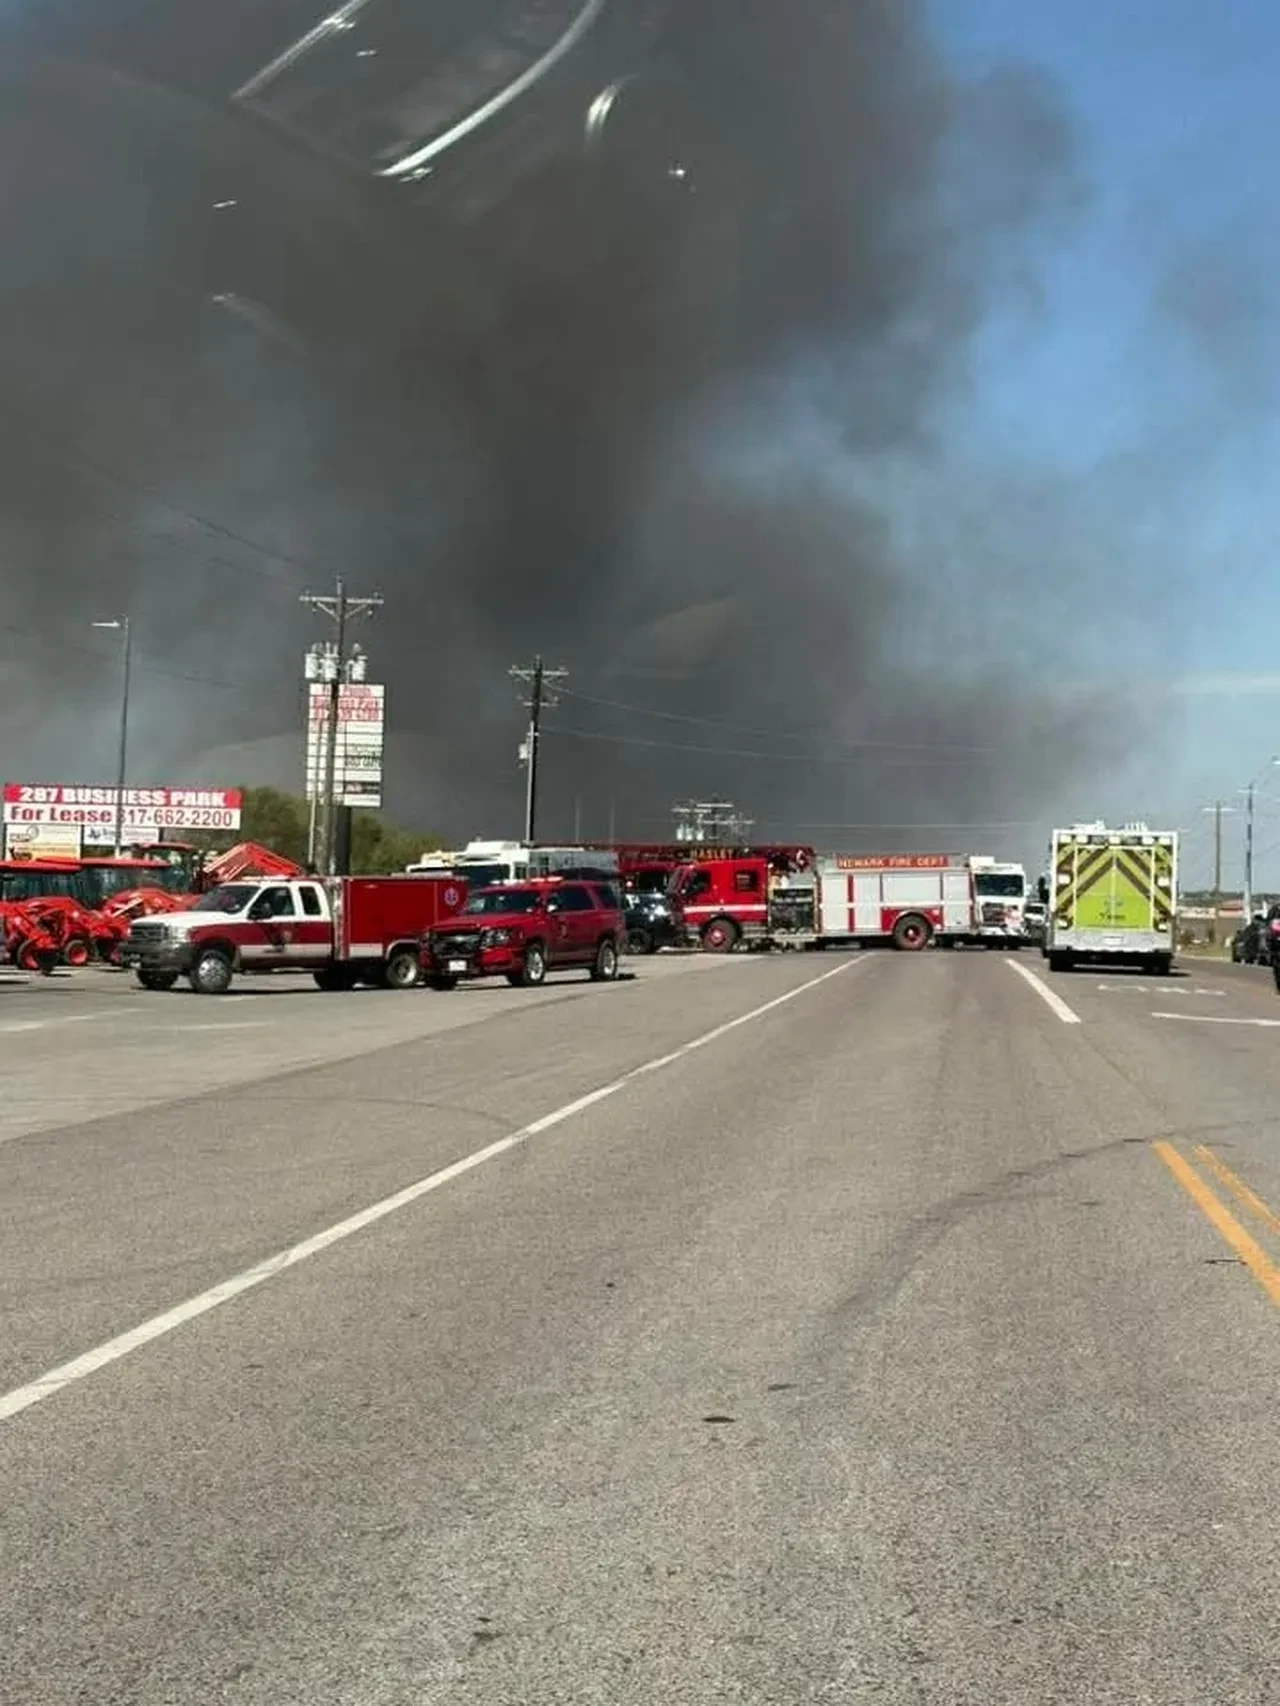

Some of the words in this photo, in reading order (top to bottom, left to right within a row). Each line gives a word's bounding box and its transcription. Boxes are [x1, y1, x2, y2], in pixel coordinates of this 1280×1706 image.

[19, 787, 59, 803] 287
[63, 788, 166, 806] BUSINESS
[170, 791, 226, 808] PARK
[10, 806, 44, 820] For
[49, 807, 113, 823] Lease
[838, 858, 885, 868] NEWARK
[889, 857, 912, 867] FIRE
[916, 856, 946, 867] DEPT
